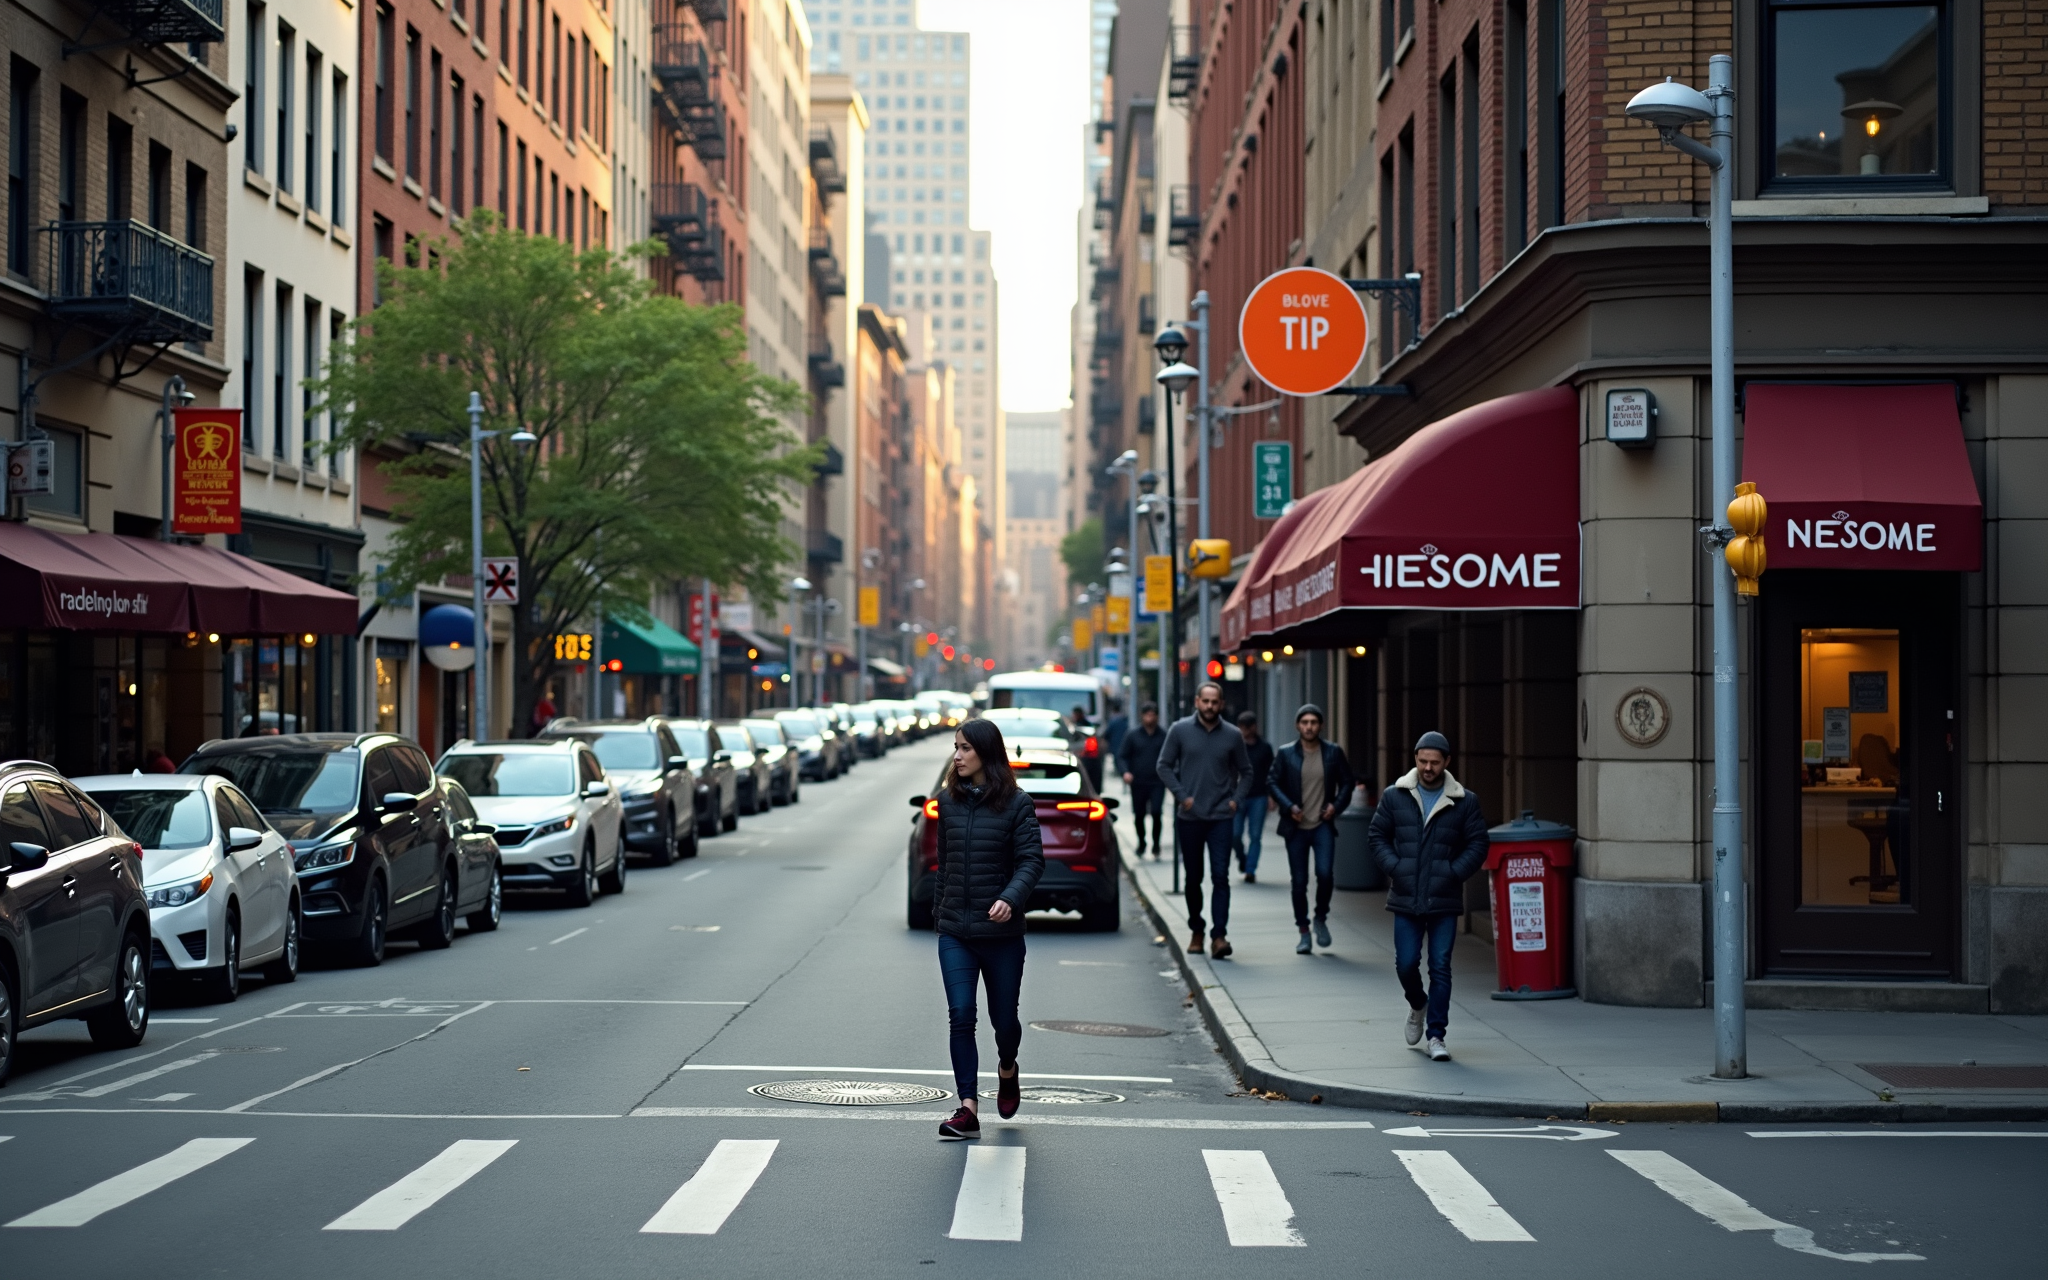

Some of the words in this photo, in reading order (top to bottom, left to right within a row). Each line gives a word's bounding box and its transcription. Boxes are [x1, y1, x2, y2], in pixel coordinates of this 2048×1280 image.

[1282, 293, 1329, 308] BLOVE
[1279, 316, 1330, 350] TIP
[1787, 518, 1937, 552] NESOME
